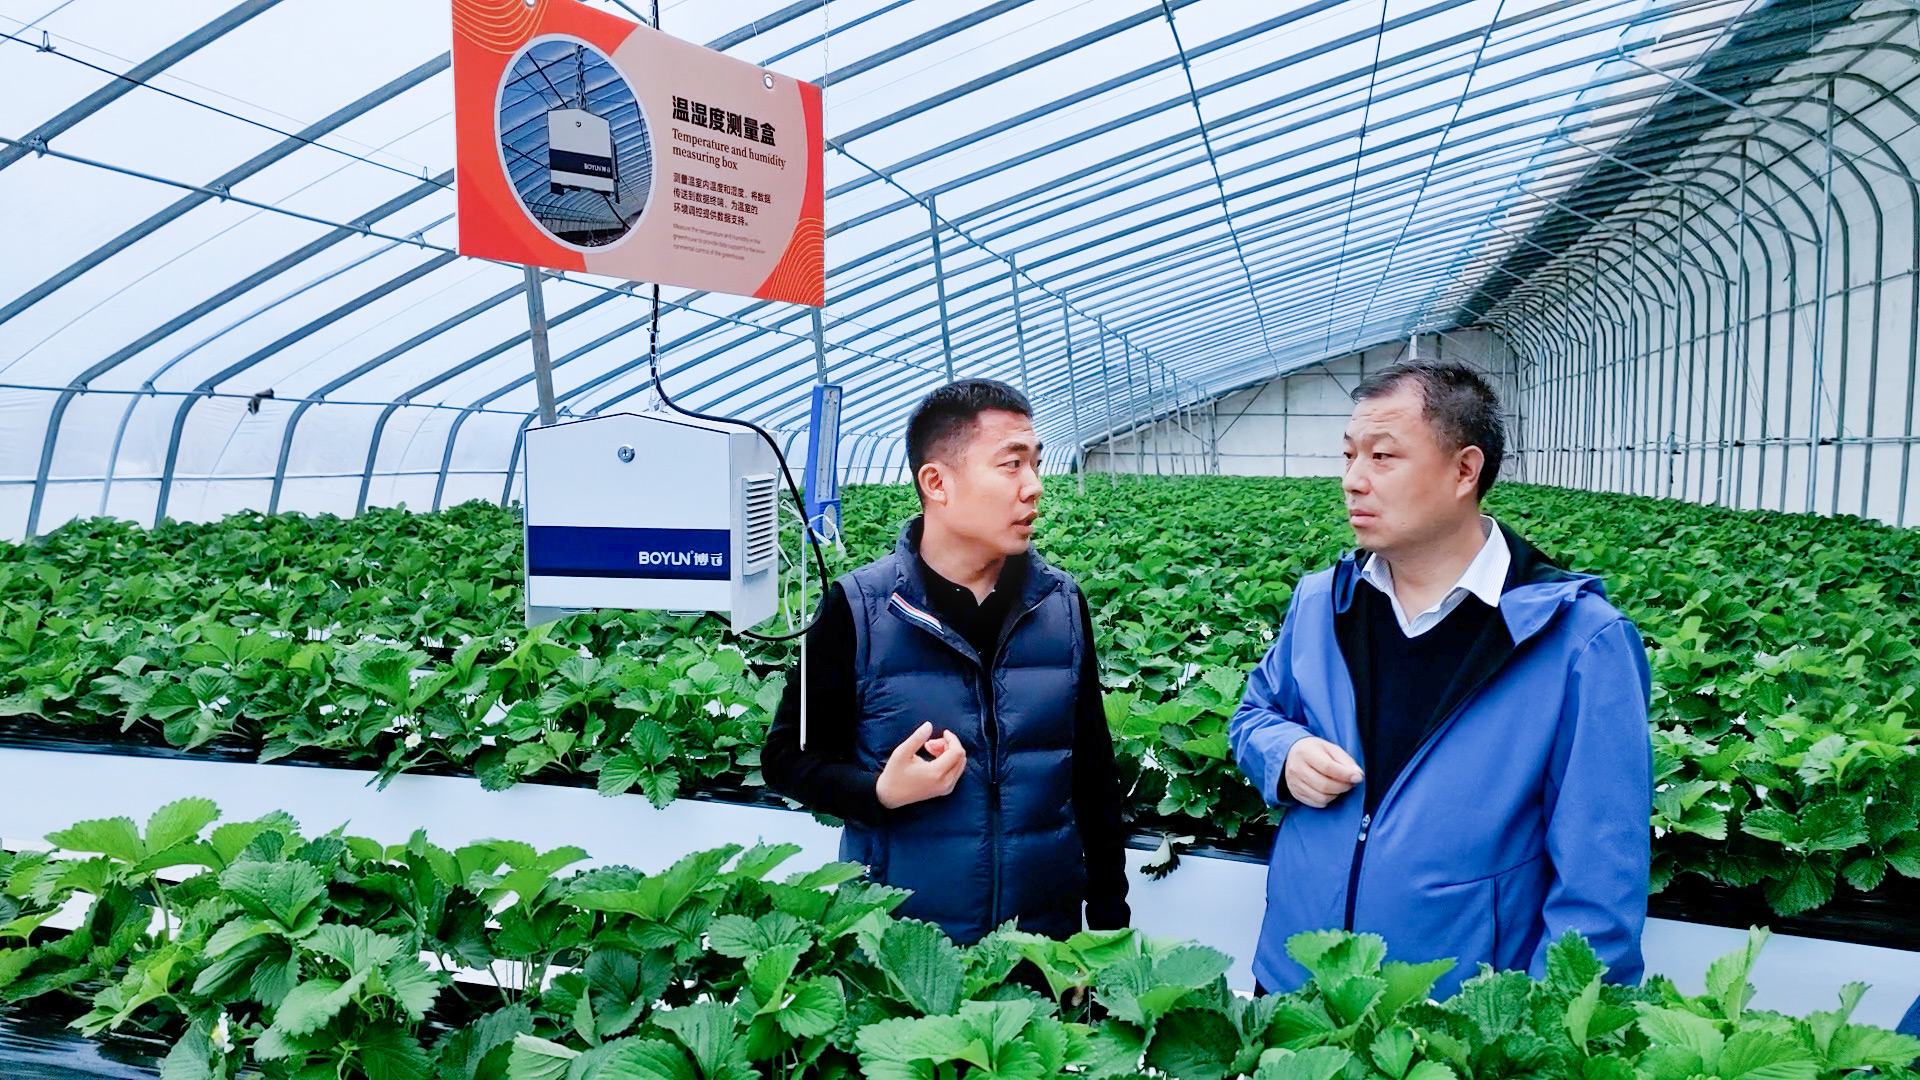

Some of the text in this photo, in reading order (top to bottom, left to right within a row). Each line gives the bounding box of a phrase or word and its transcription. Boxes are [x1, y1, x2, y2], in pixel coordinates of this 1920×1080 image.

[672, 95, 776, 146] 温湿度测量盒
[672, 128, 786, 170] Temperature and humidity
[672, 146, 738, 170] measuring box
